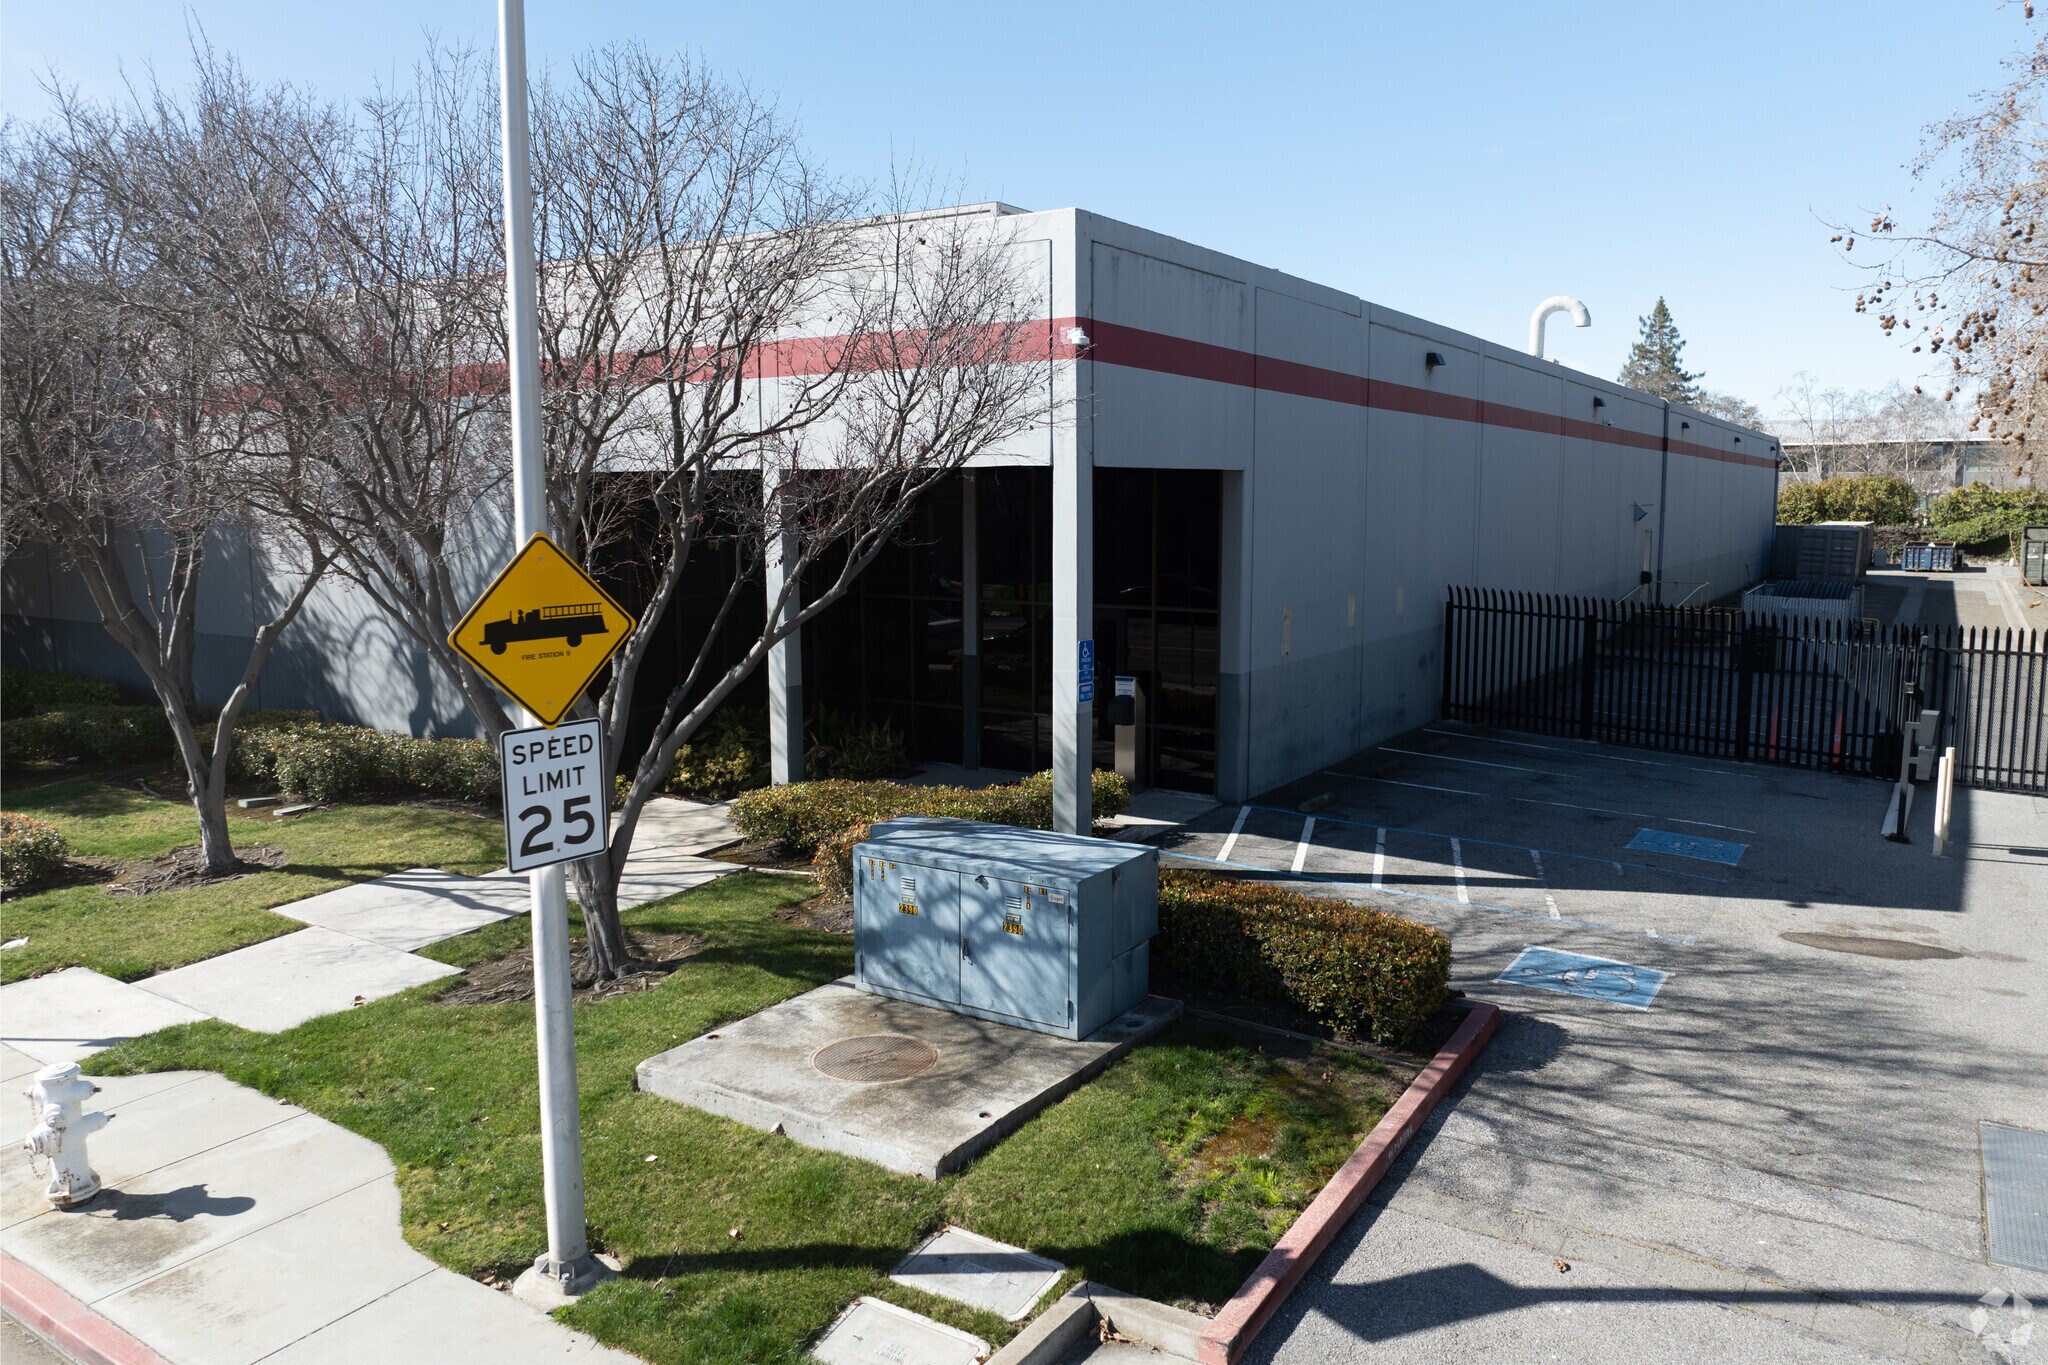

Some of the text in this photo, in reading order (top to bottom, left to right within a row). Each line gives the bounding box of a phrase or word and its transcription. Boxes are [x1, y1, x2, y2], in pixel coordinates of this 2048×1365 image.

[538, 651, 564, 660] STATION
[512, 734, 593, 765] SPEED
[523, 765, 585, 796] LIMIT
[518, 795, 595, 857] 25
[899, 903, 918, 915] 2390
[1004, 922, 1023, 935] 2390
